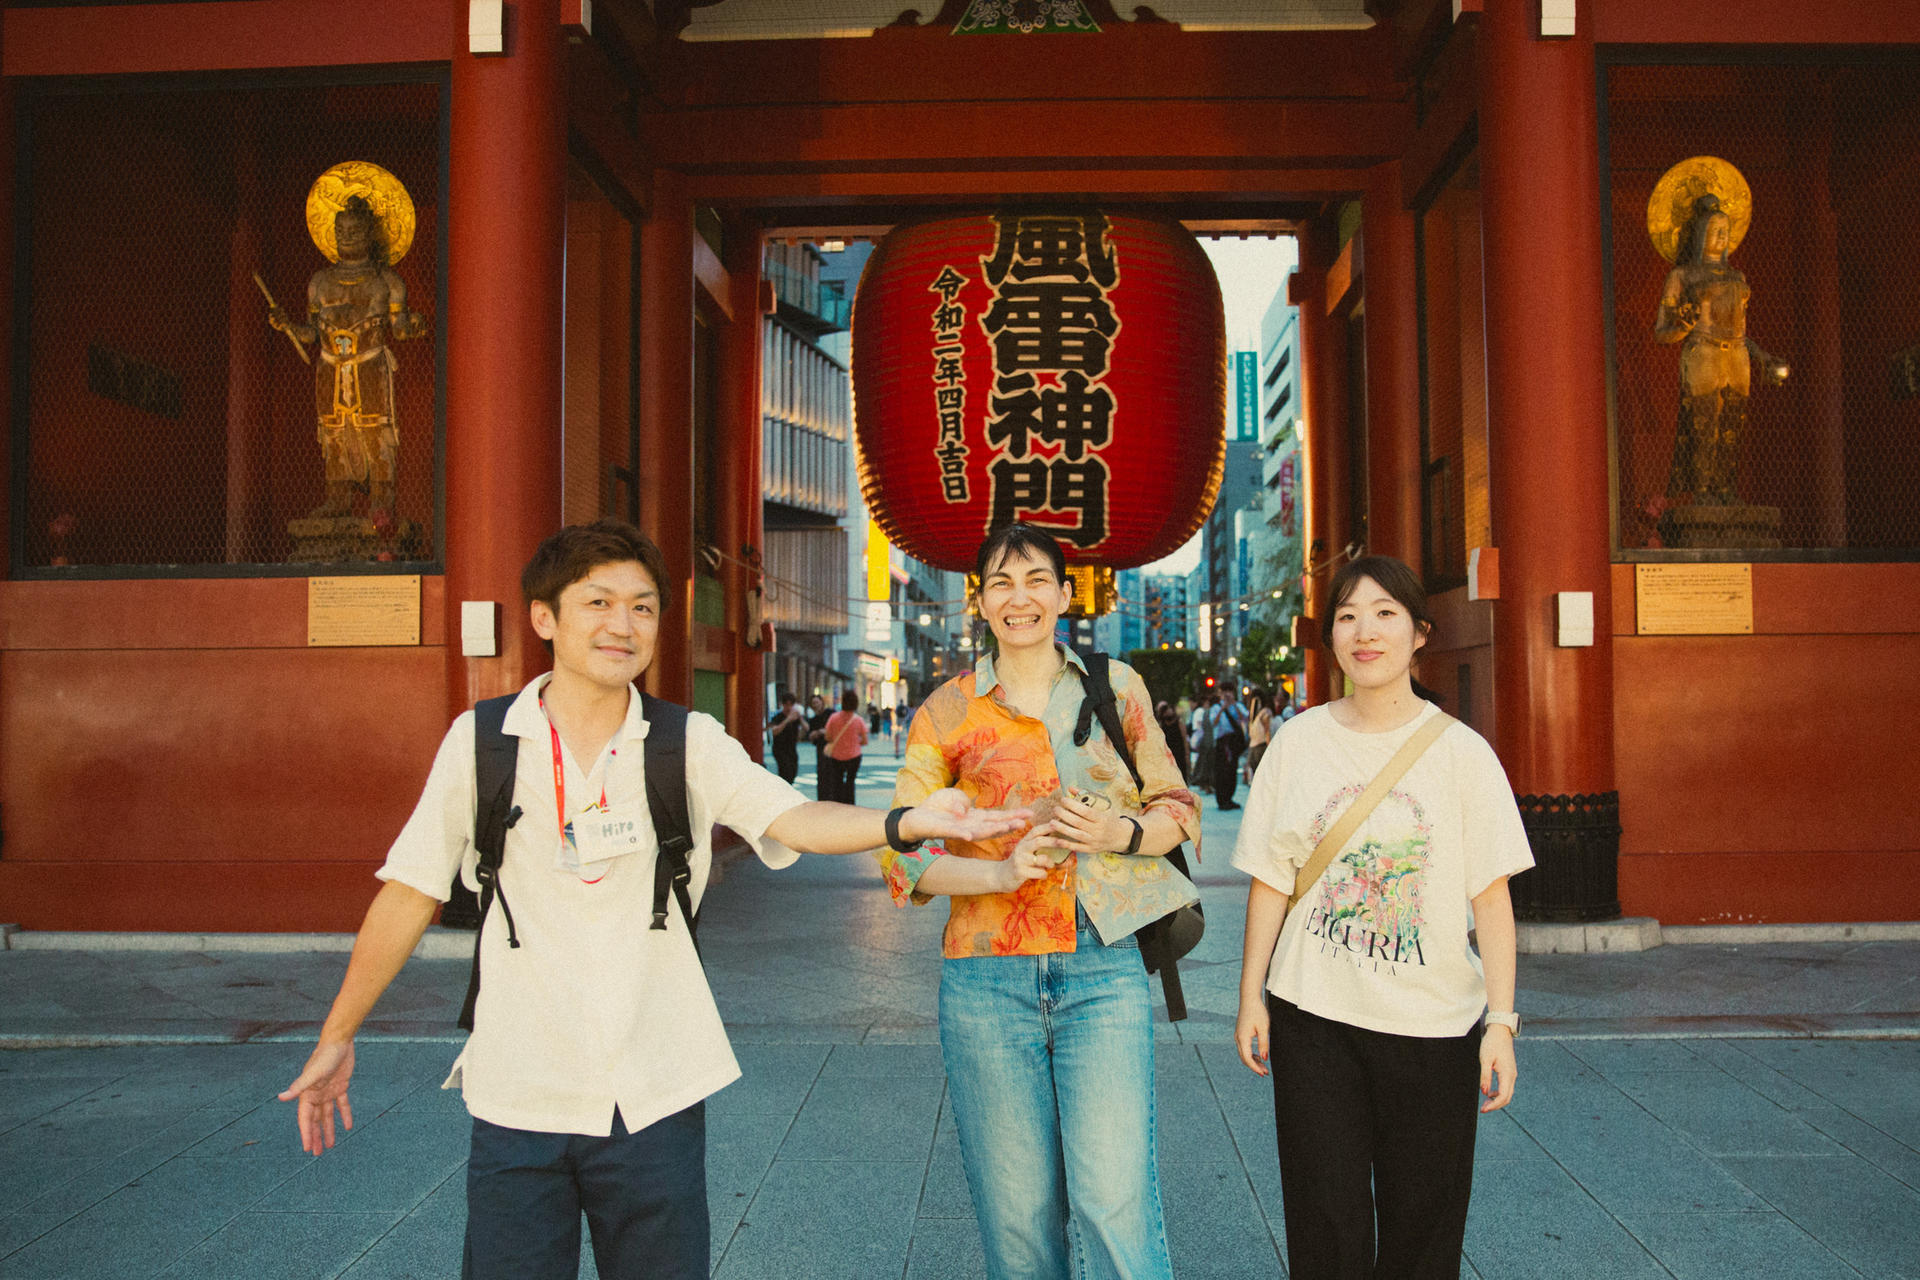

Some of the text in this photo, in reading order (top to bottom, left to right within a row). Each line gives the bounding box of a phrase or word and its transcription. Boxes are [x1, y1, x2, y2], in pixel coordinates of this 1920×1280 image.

[929, 265, 971, 503] 令和二年四月吉日
[979, 214, 1122, 549] 風雷神門
[602, 821, 633, 837] Hiro
[1305, 907, 1426, 966] LIGURIA
